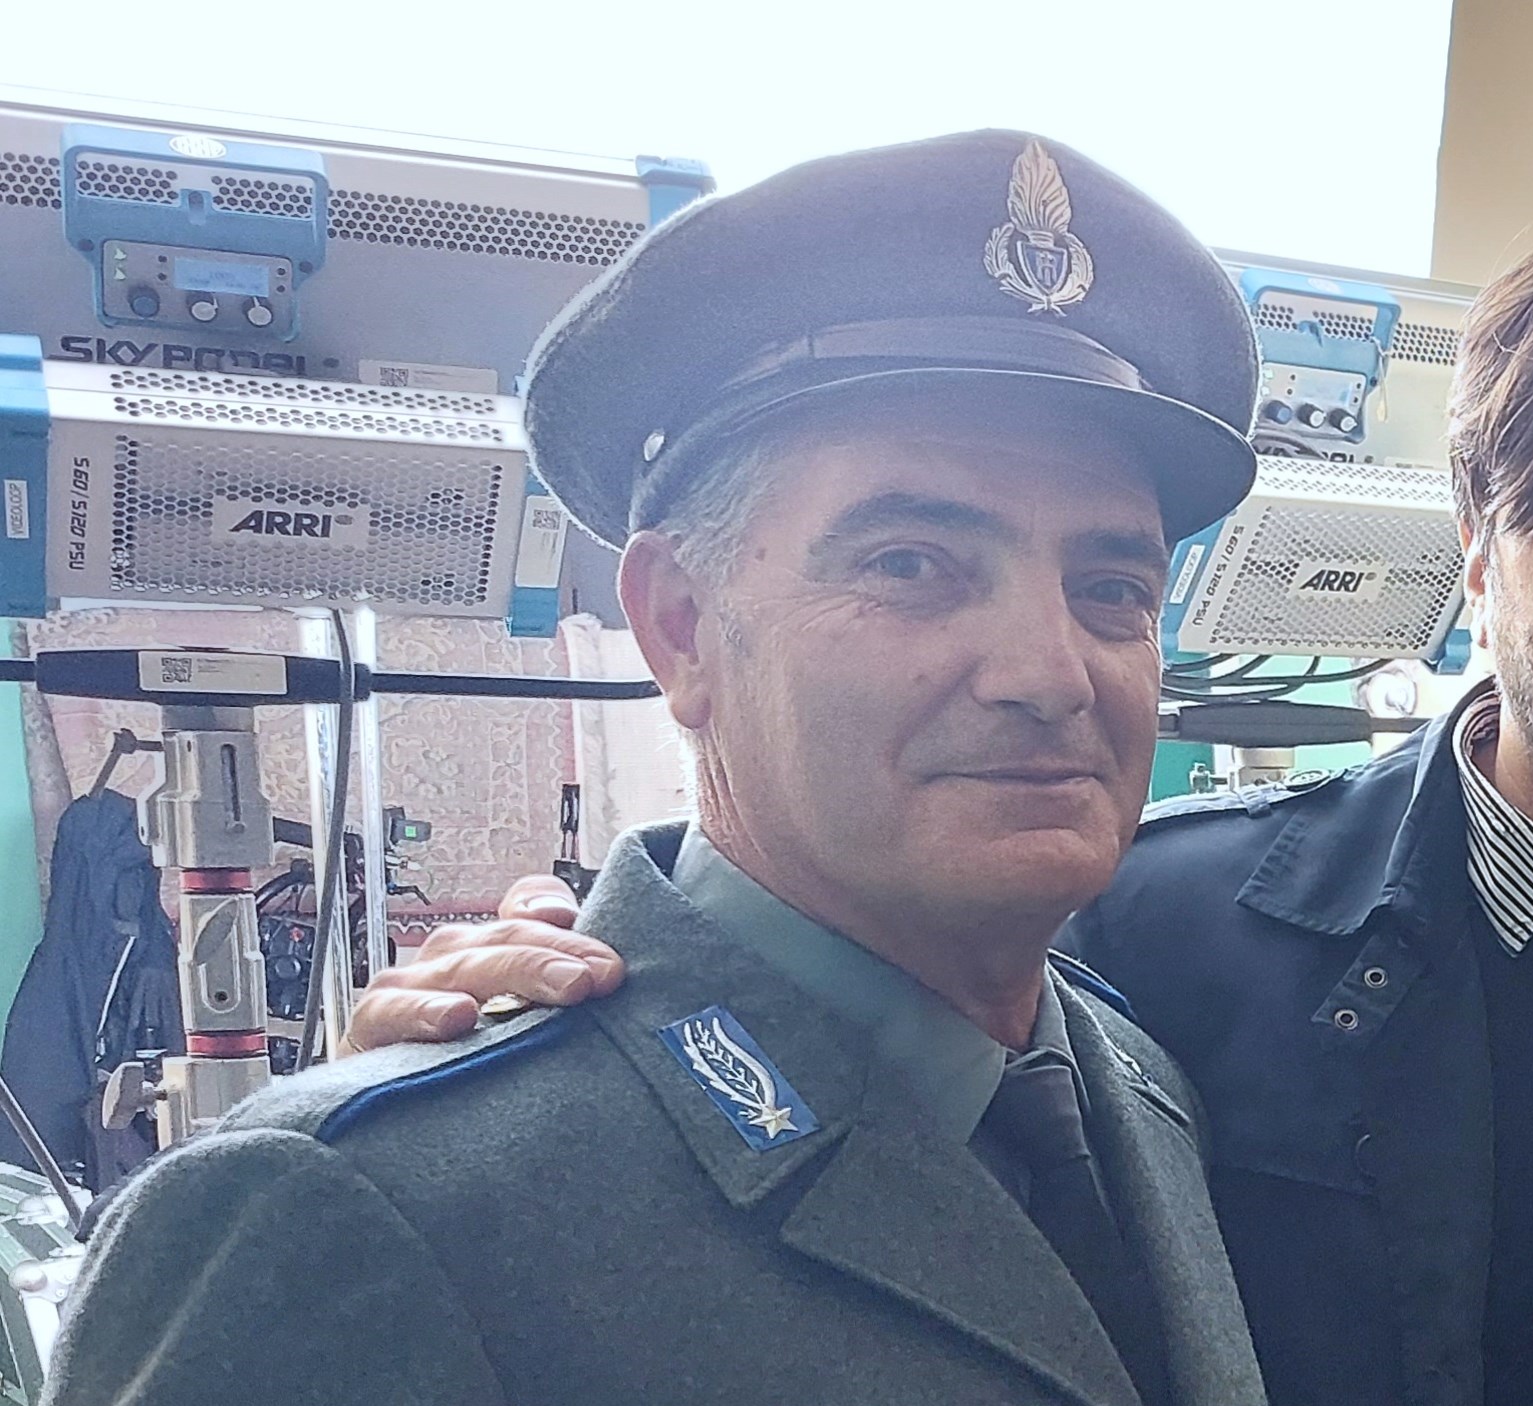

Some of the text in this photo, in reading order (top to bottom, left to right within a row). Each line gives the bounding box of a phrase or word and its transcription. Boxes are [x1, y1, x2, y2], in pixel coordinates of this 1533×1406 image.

[228, 509, 332, 538] ARRI
[68, 541, 86, 570] PSU
[1300, 569, 1365, 593] ARRI
[1192, 600, 1211, 626] PSU
